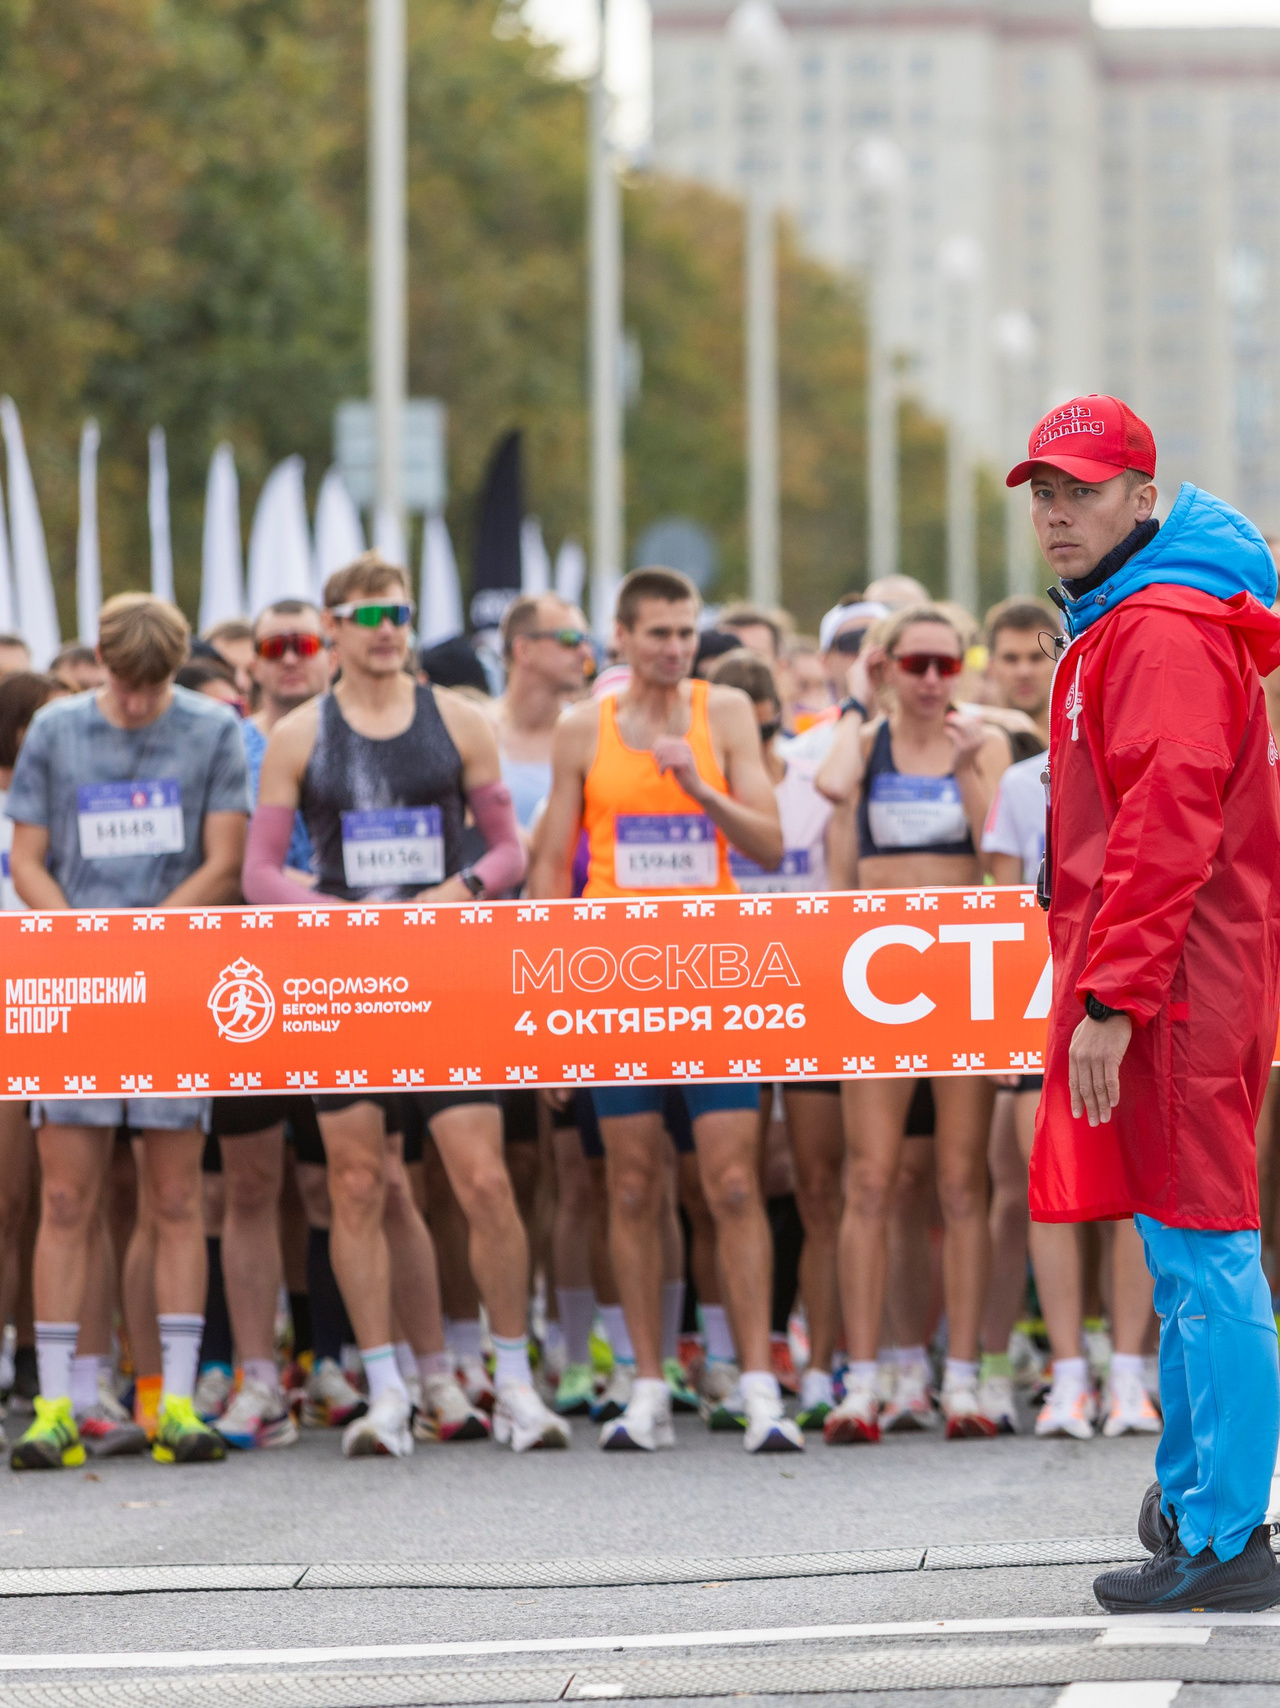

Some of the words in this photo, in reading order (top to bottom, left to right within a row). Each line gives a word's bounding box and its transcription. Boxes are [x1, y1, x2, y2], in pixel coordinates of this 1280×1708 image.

[1033, 419, 1105, 454] Running
[1038, 405, 1091, 437] Russia
[512, 941, 801, 995] МОСКВА
[5, 970, 147, 1004] МОСКОВСКИЙ
[283, 976, 409, 1001] фармэко
[5, 1006, 72, 1034] СПОРТ
[283, 1003, 328, 1016] БЕГОМ
[330, 1001, 352, 1015] ПО
[354, 1000, 432, 1014] ЗОЛОТОМУ
[514, 1010, 537, 1036] 4
[546, 1005, 712, 1036] ОКТЯБРЯ
[722, 1003, 806, 1031] 2026
[283, 1019, 341, 1033] КОЛЬЦУ
